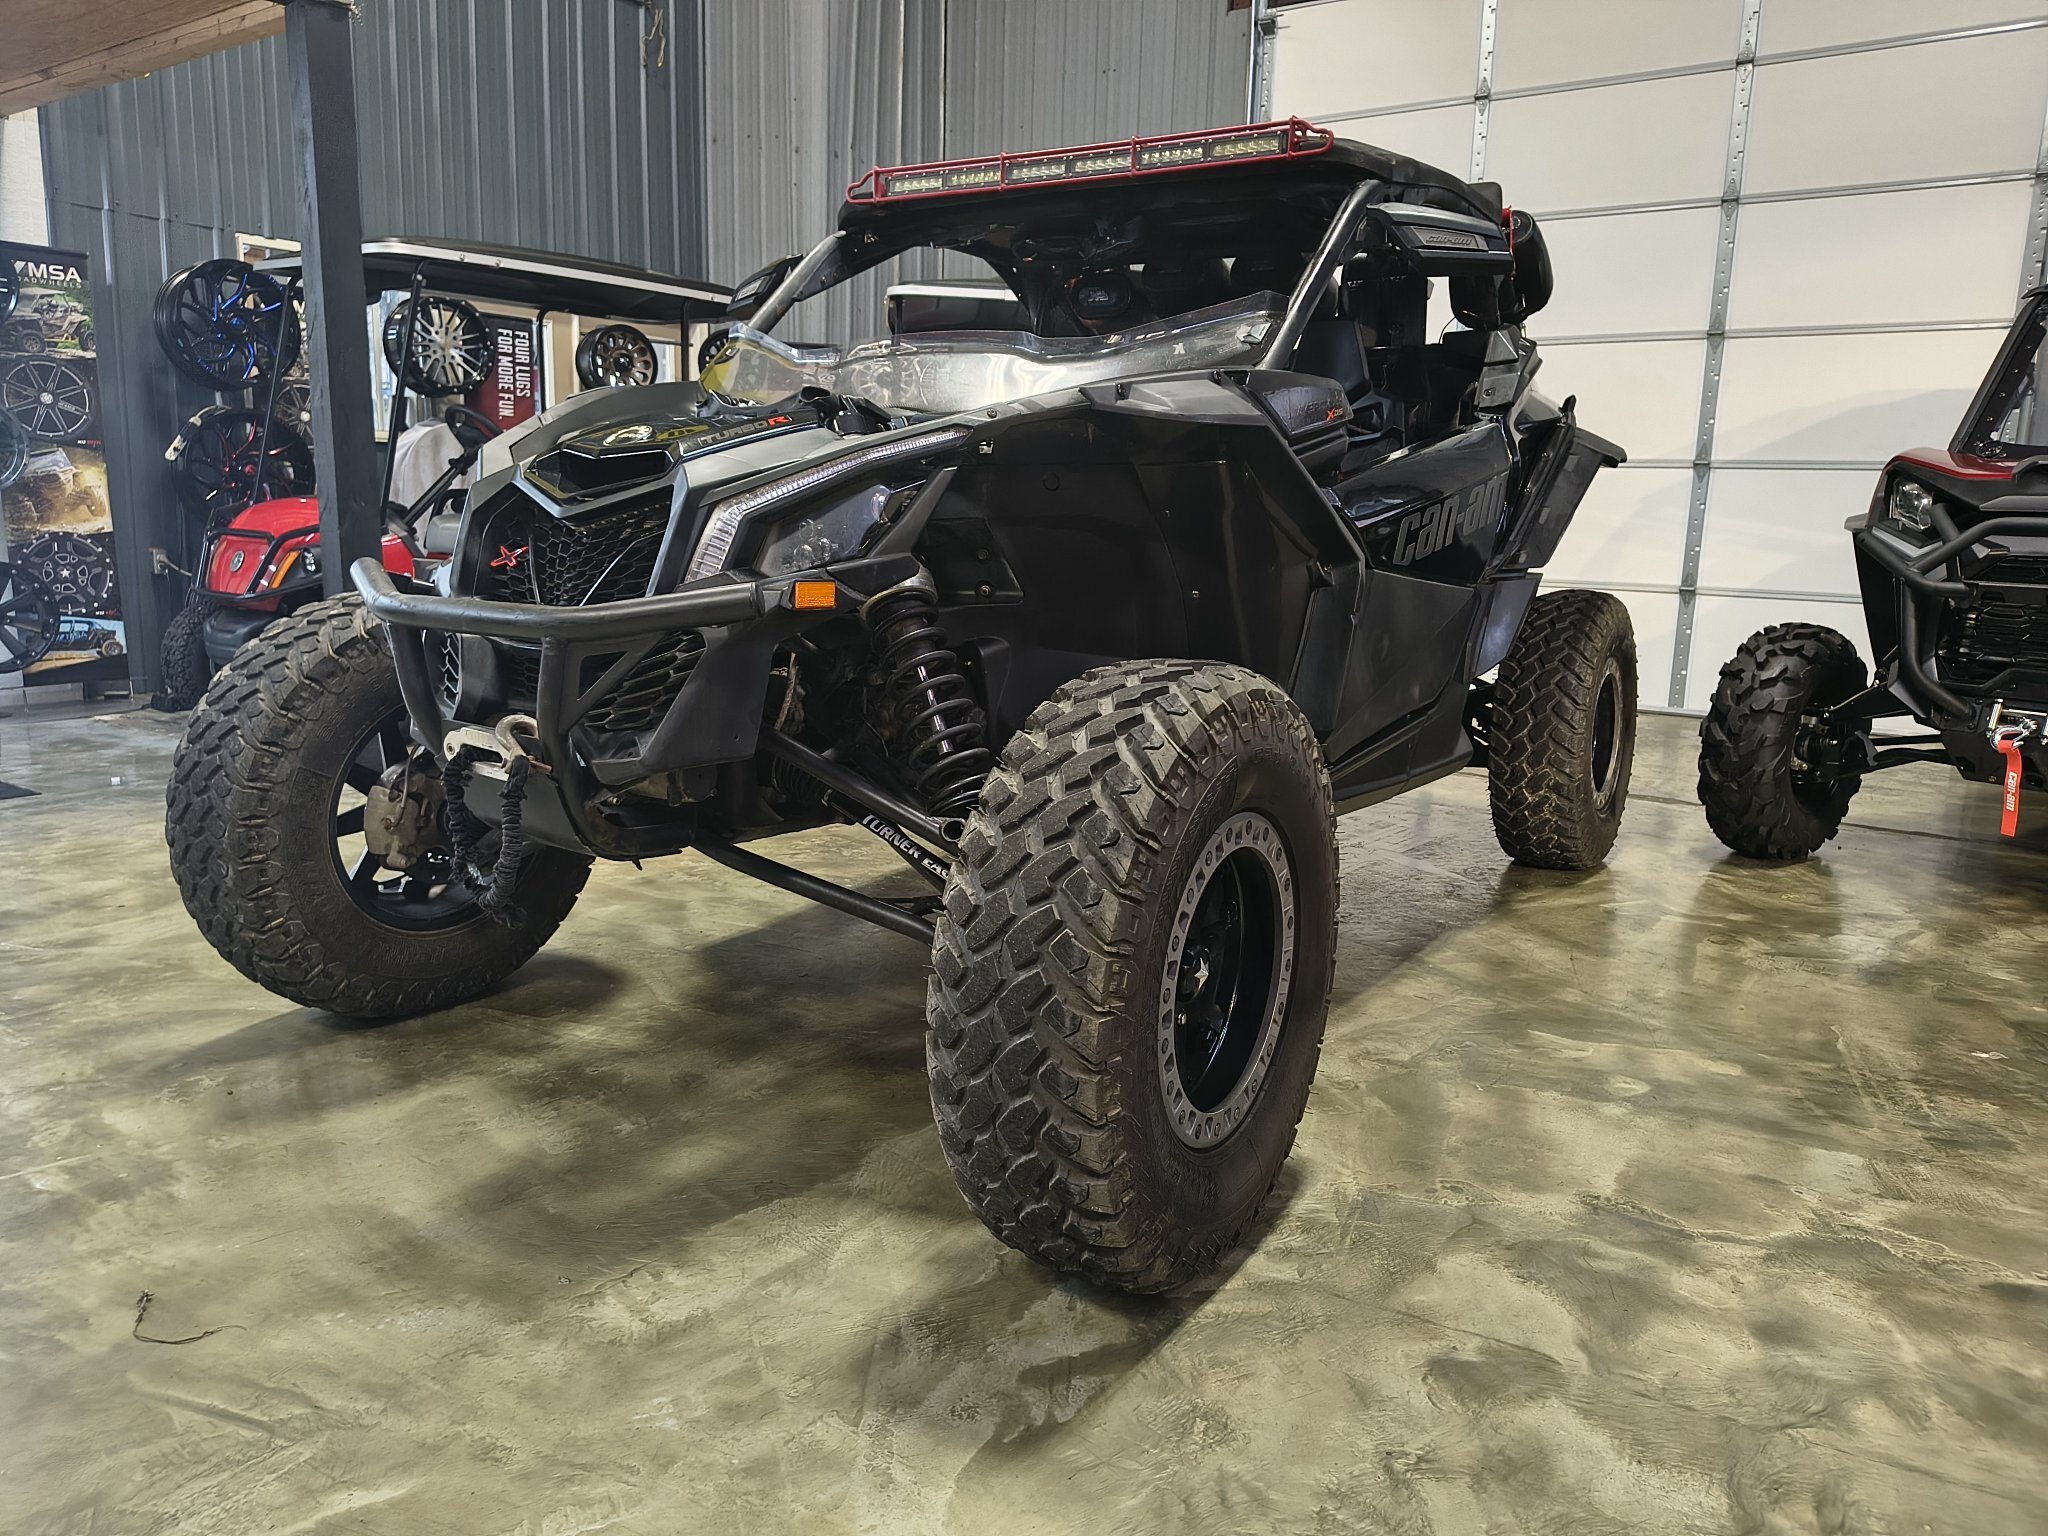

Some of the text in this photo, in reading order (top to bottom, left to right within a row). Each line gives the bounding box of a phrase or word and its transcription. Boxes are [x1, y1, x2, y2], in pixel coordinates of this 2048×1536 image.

[27, 261, 83, 283] MSA
[497, 328, 515, 420] FOR MORE FUN.
[514, 331, 531, 397] FOUR LUGS
[1393, 472, 1509, 566] can-am
[2006, 771, 2018, 812] can-am
[862, 814, 922, 859] TURNER
